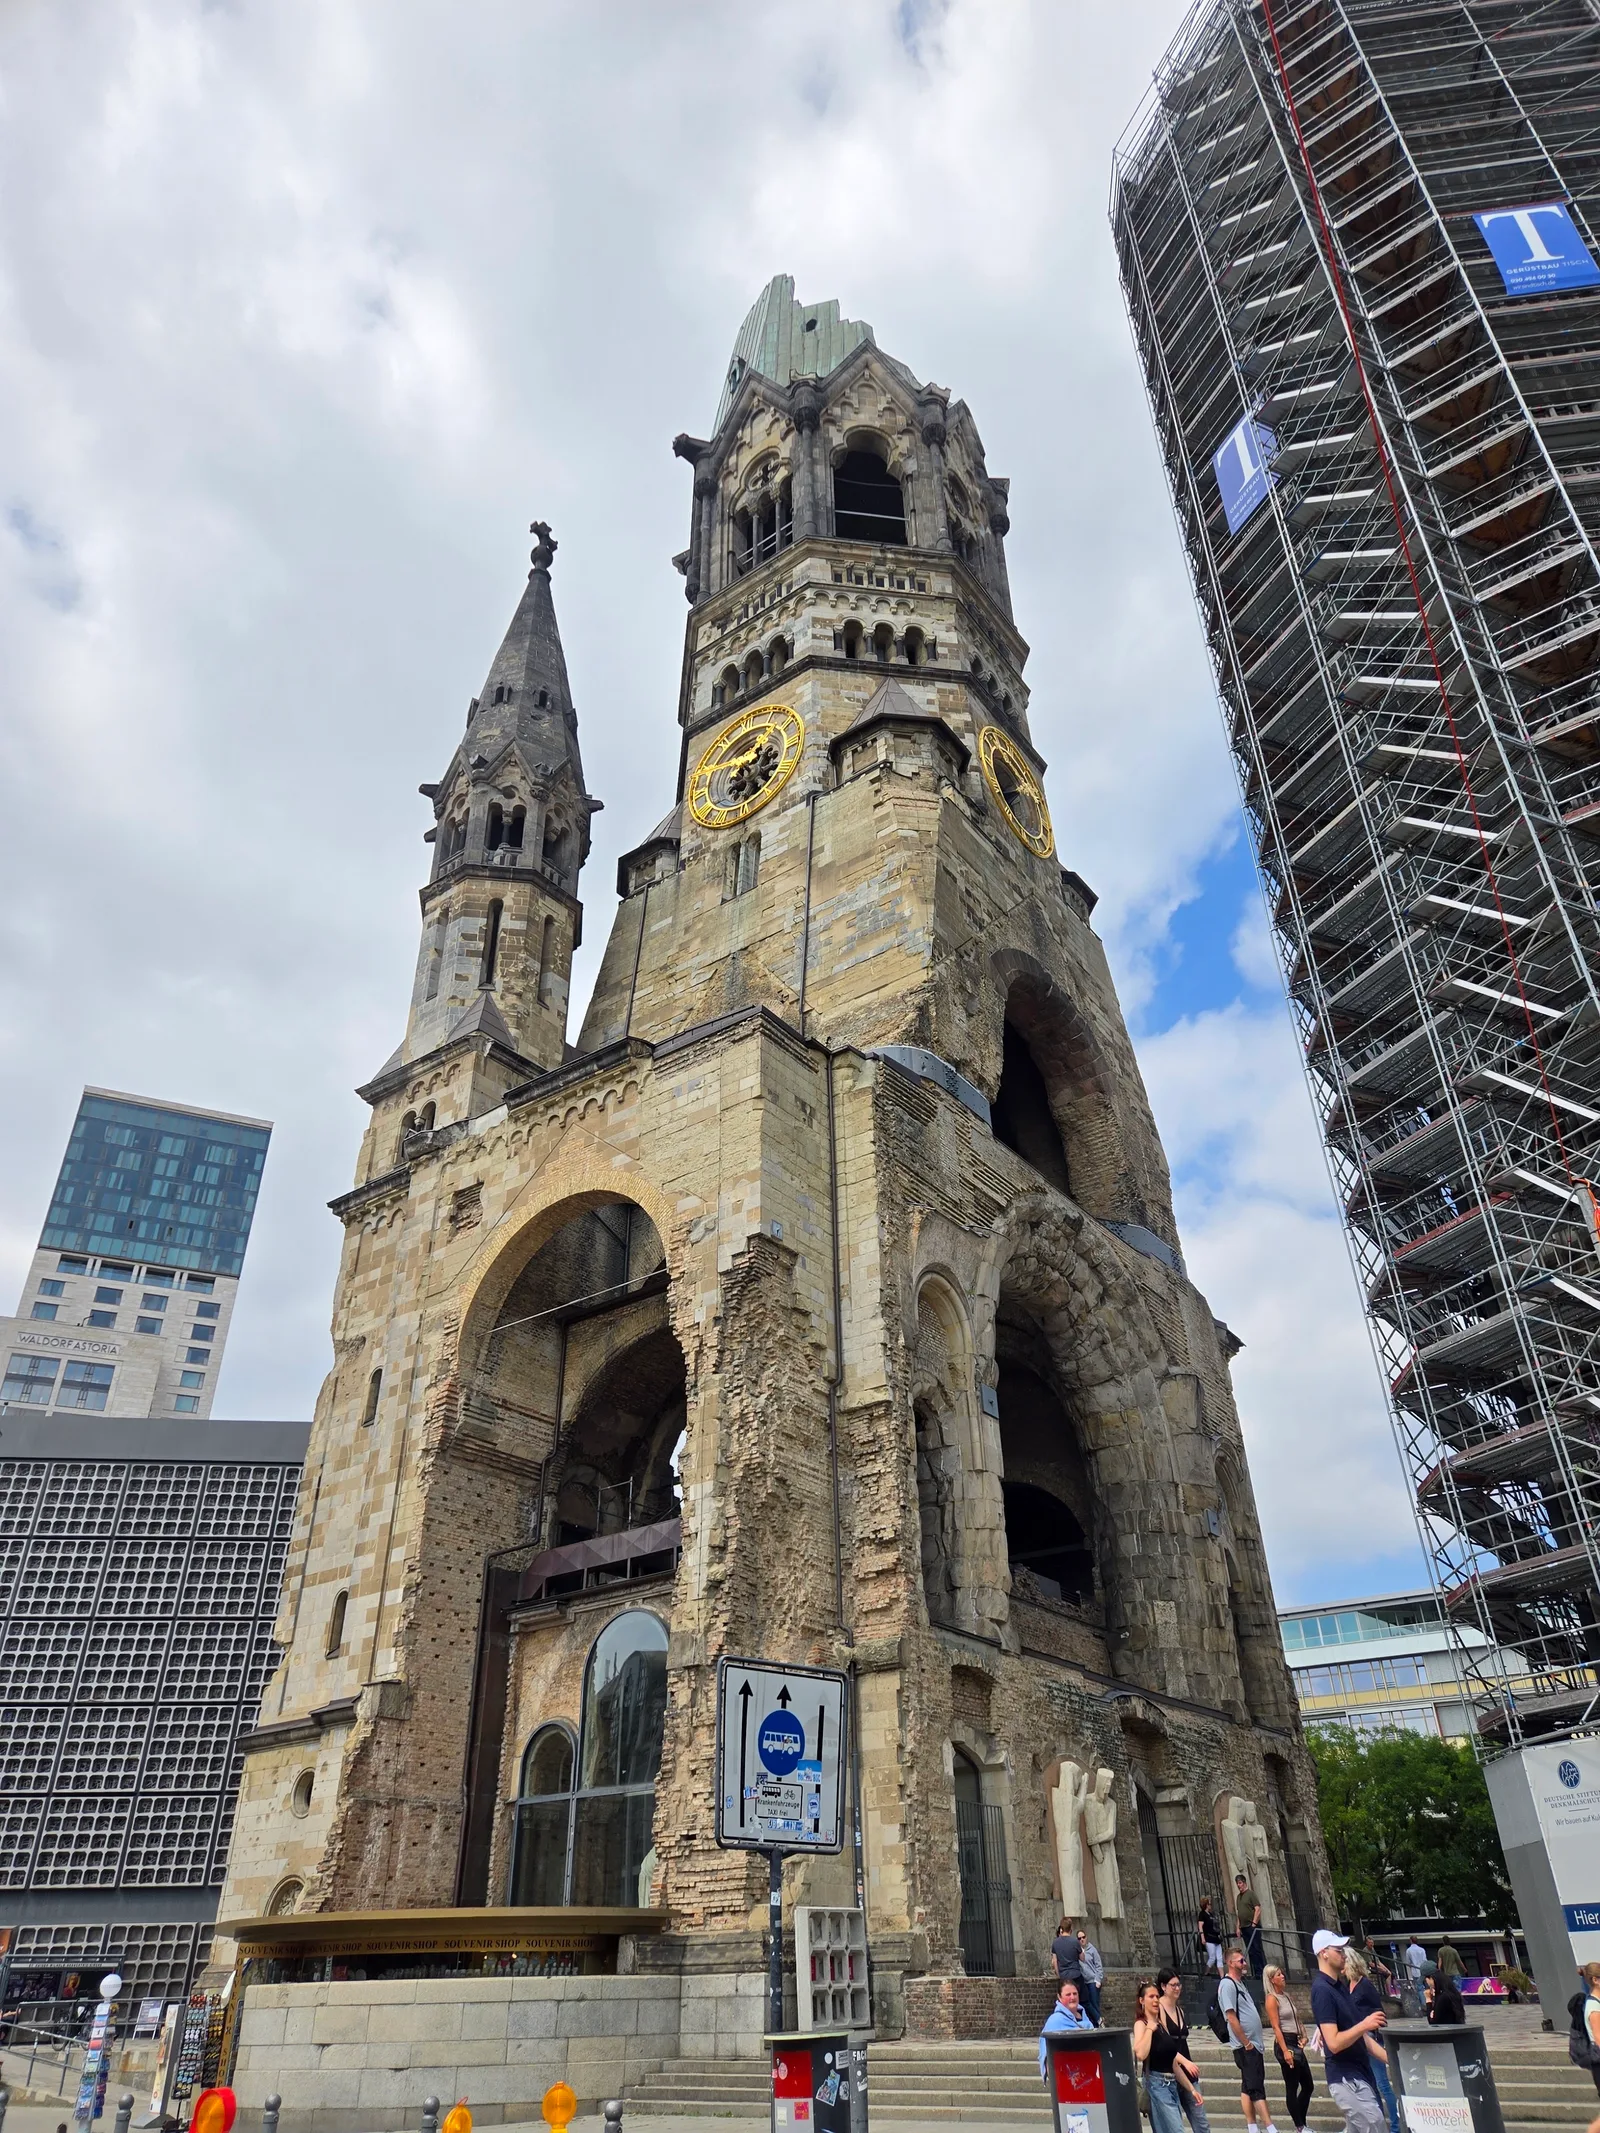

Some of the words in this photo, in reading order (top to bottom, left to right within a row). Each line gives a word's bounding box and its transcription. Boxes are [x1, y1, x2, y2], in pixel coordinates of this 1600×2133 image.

[1481, 206, 1565, 264] T
[1506, 263, 1559, 275] GERÜSTBAU
[1562, 259, 1589, 268] TISCH
[1217, 410, 1261, 493] T
[20, 1334, 73, 1348] WALDORF
[74, 1341, 117, 1354] ASTORIA
[758, 1799, 799, 1809] Krankenfahrzeuge
[1544, 1794, 1574, 1803] DEUTSCHE
[768, 1808, 777, 1816] TAXI
[1583, 1815, 1591, 1823] auf
[1574, 1910, 1599, 1925] Hier
[239, 1945, 283, 1955] SOUVENIR
[341, 1942, 362, 1951] SHOP
[367, 1941, 410, 1950] SOUVENIR
[413, 1940, 438, 1949] SHOP
[444, 1939, 493, 1948] SOUVENIR
[495, 1939, 520, 1948] SHOP
[526, 1939, 571, 1948] SOUVENIR
[572, 1939, 595, 1948] SHOP
[1423, 2115, 1468, 2126] konzert
